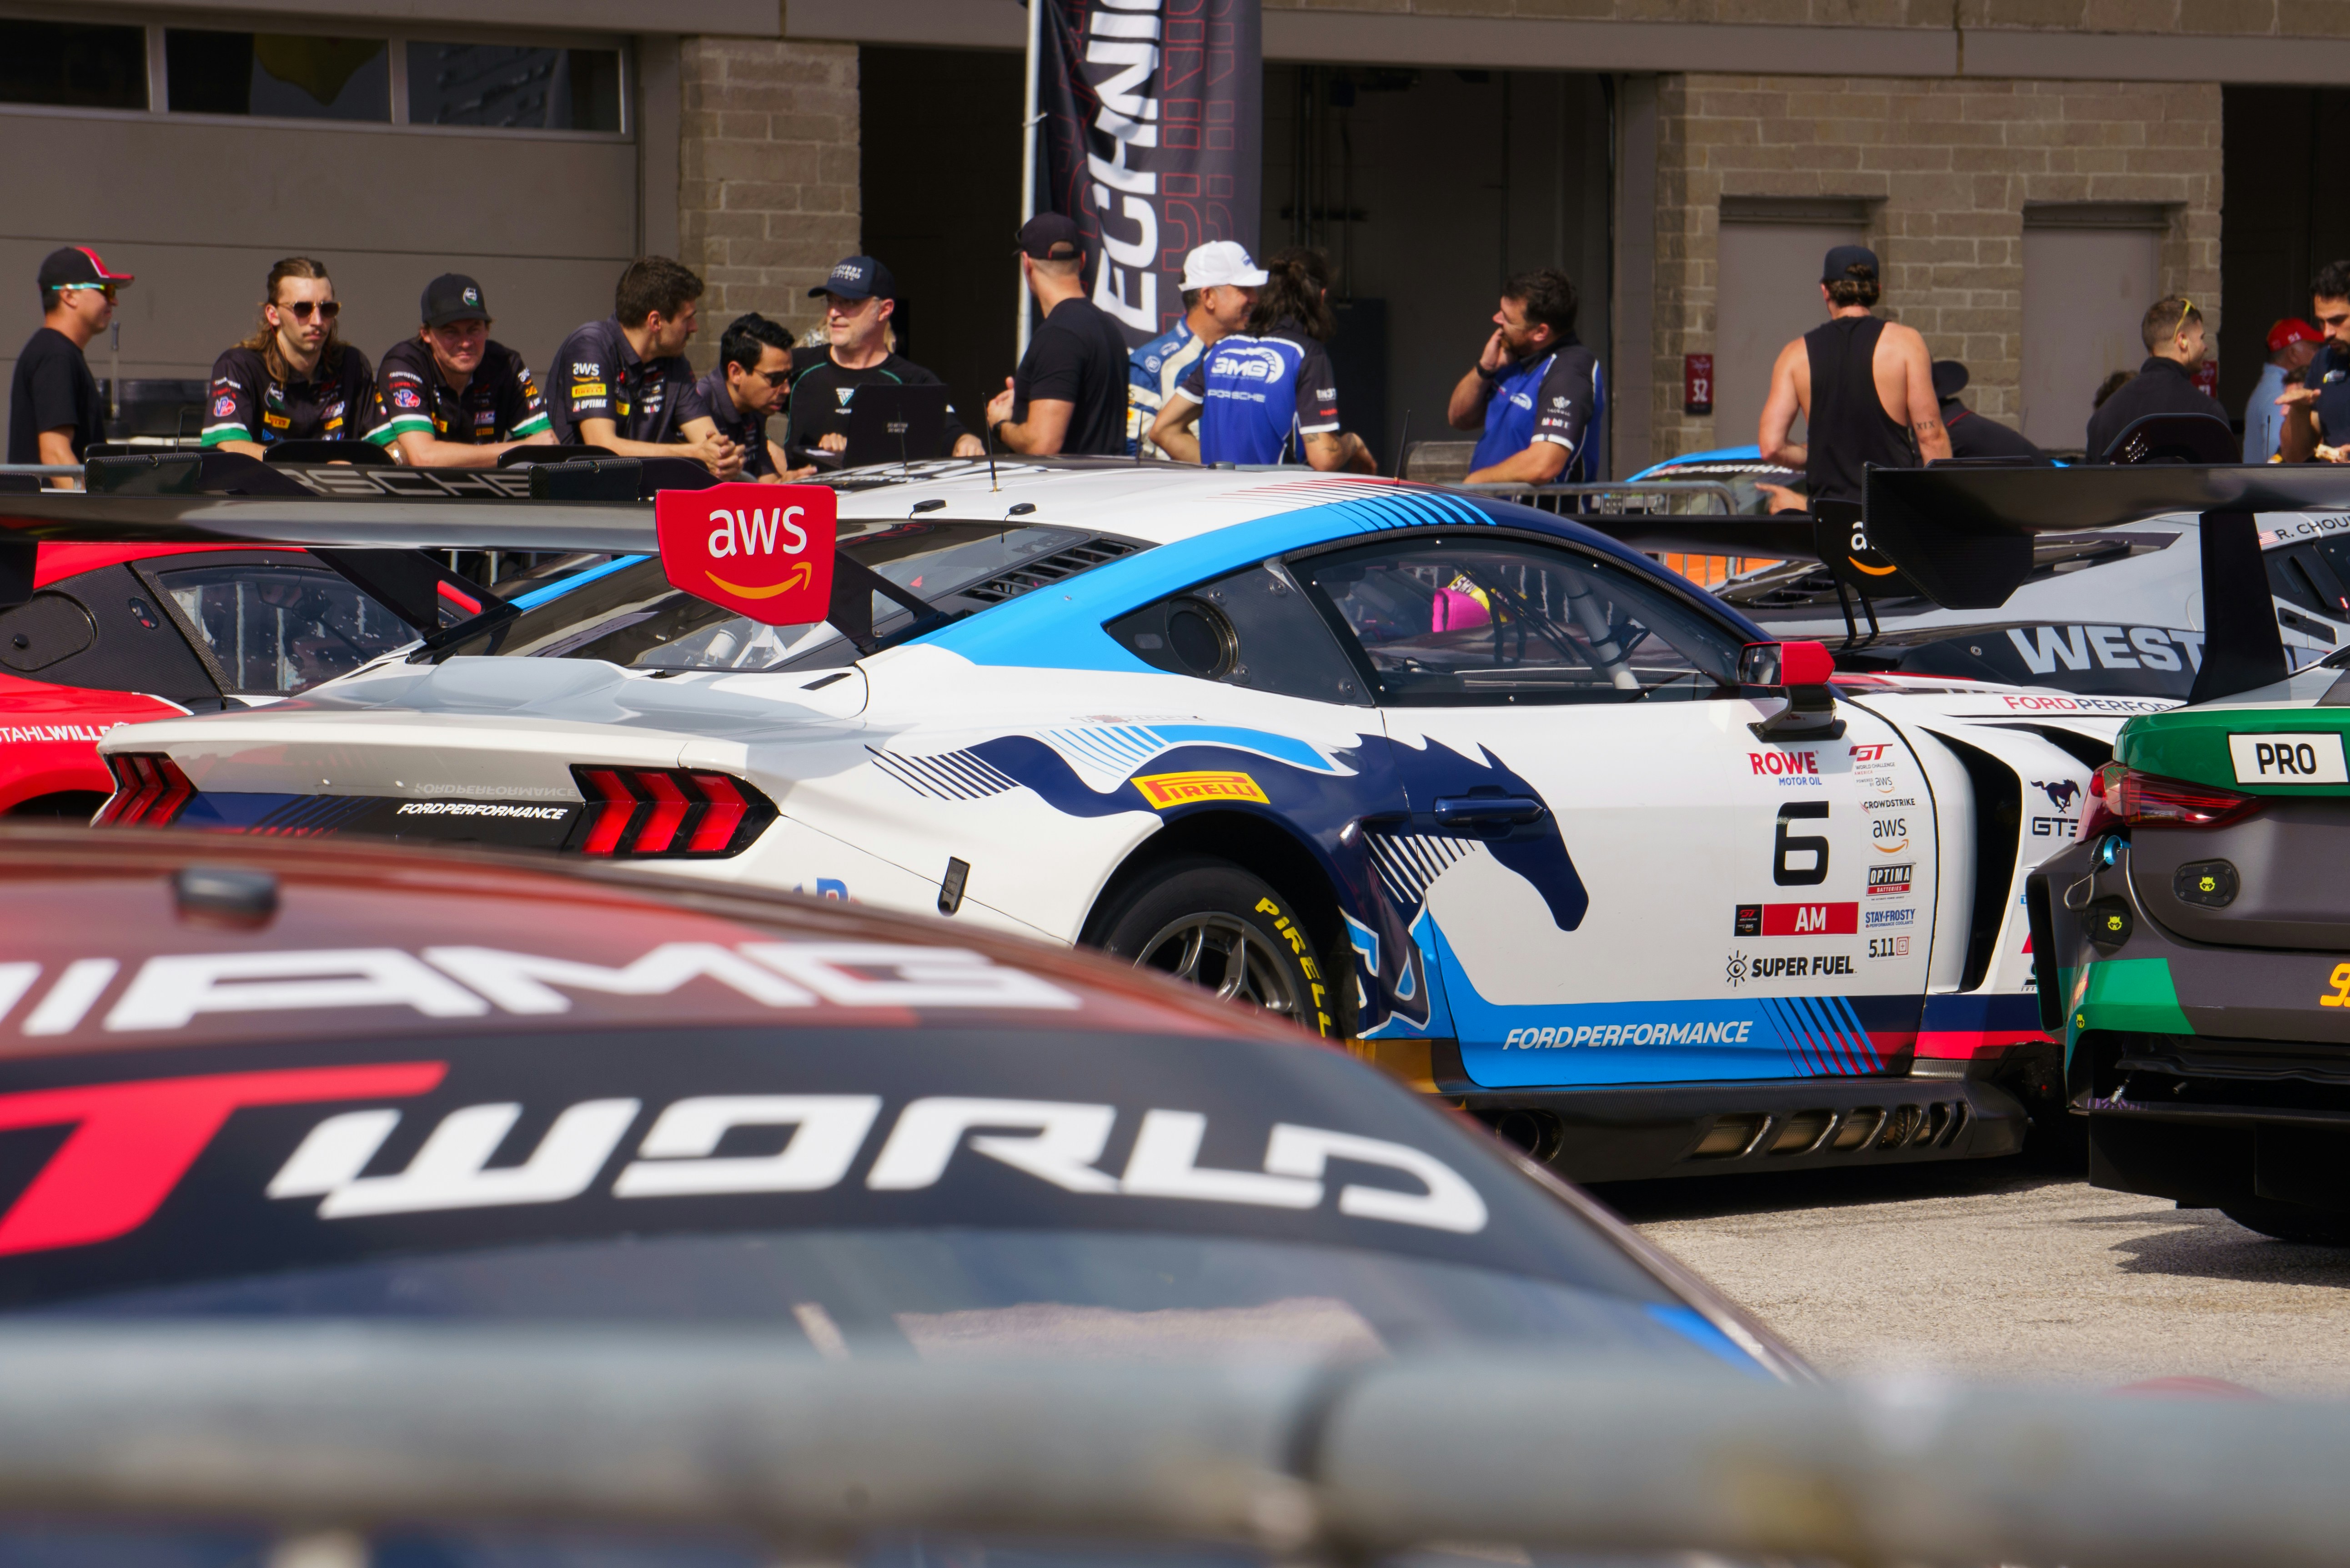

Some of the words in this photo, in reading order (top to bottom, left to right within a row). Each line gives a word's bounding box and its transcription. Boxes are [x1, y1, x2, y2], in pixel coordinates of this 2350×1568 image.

[1086, 0, 1159, 333] ECHNI
[573, 362, 600, 376] aws
[1207, 389, 1266, 402] PORSCHE
[1692, 379, 1708, 402] 32
[581, 399, 607, 409] OPTIMA
[1916, 420, 1935, 430] XIX
[277, 469, 529, 497] RSCHE
[708, 506, 807, 558] aws
[2275, 529, 2295, 540] R.
[2296, 516, 2350, 534] CHOU
[0, 726, 110, 742] TAHLWILL
[1746, 752, 1818, 774] ROWE
[1848, 744, 1893, 761] GT
[2255, 743, 2318, 774] PRO
[1142, 775, 1259, 802] PIRELLI
[1779, 777, 1808, 785] MOTOR
[1809, 777, 1822, 785] OIL
[1875, 777, 1893, 786] aws
[397, 803, 568, 819] FORDPERFORMANCE
[1864, 798, 1916, 809] CROWDSTRIKE
[1873, 818, 1907, 838] aws
[1773, 801, 1829, 886] 6
[1870, 867, 1910, 884] OPTIMA
[1795, 907, 1826, 932] AM
[1869, 938, 1895, 958] 5.11
[1255, 897, 1332, 1038] PIRELL
[1751, 957, 1808, 977] SUPER
[1812, 956, 1854, 975] FUEL
[2320, 963, 2350, 1007] 9
[1502, 1021, 1753, 1050] FORDPERFORMANCE
[266, 1094, 1489, 1234] WORLD
